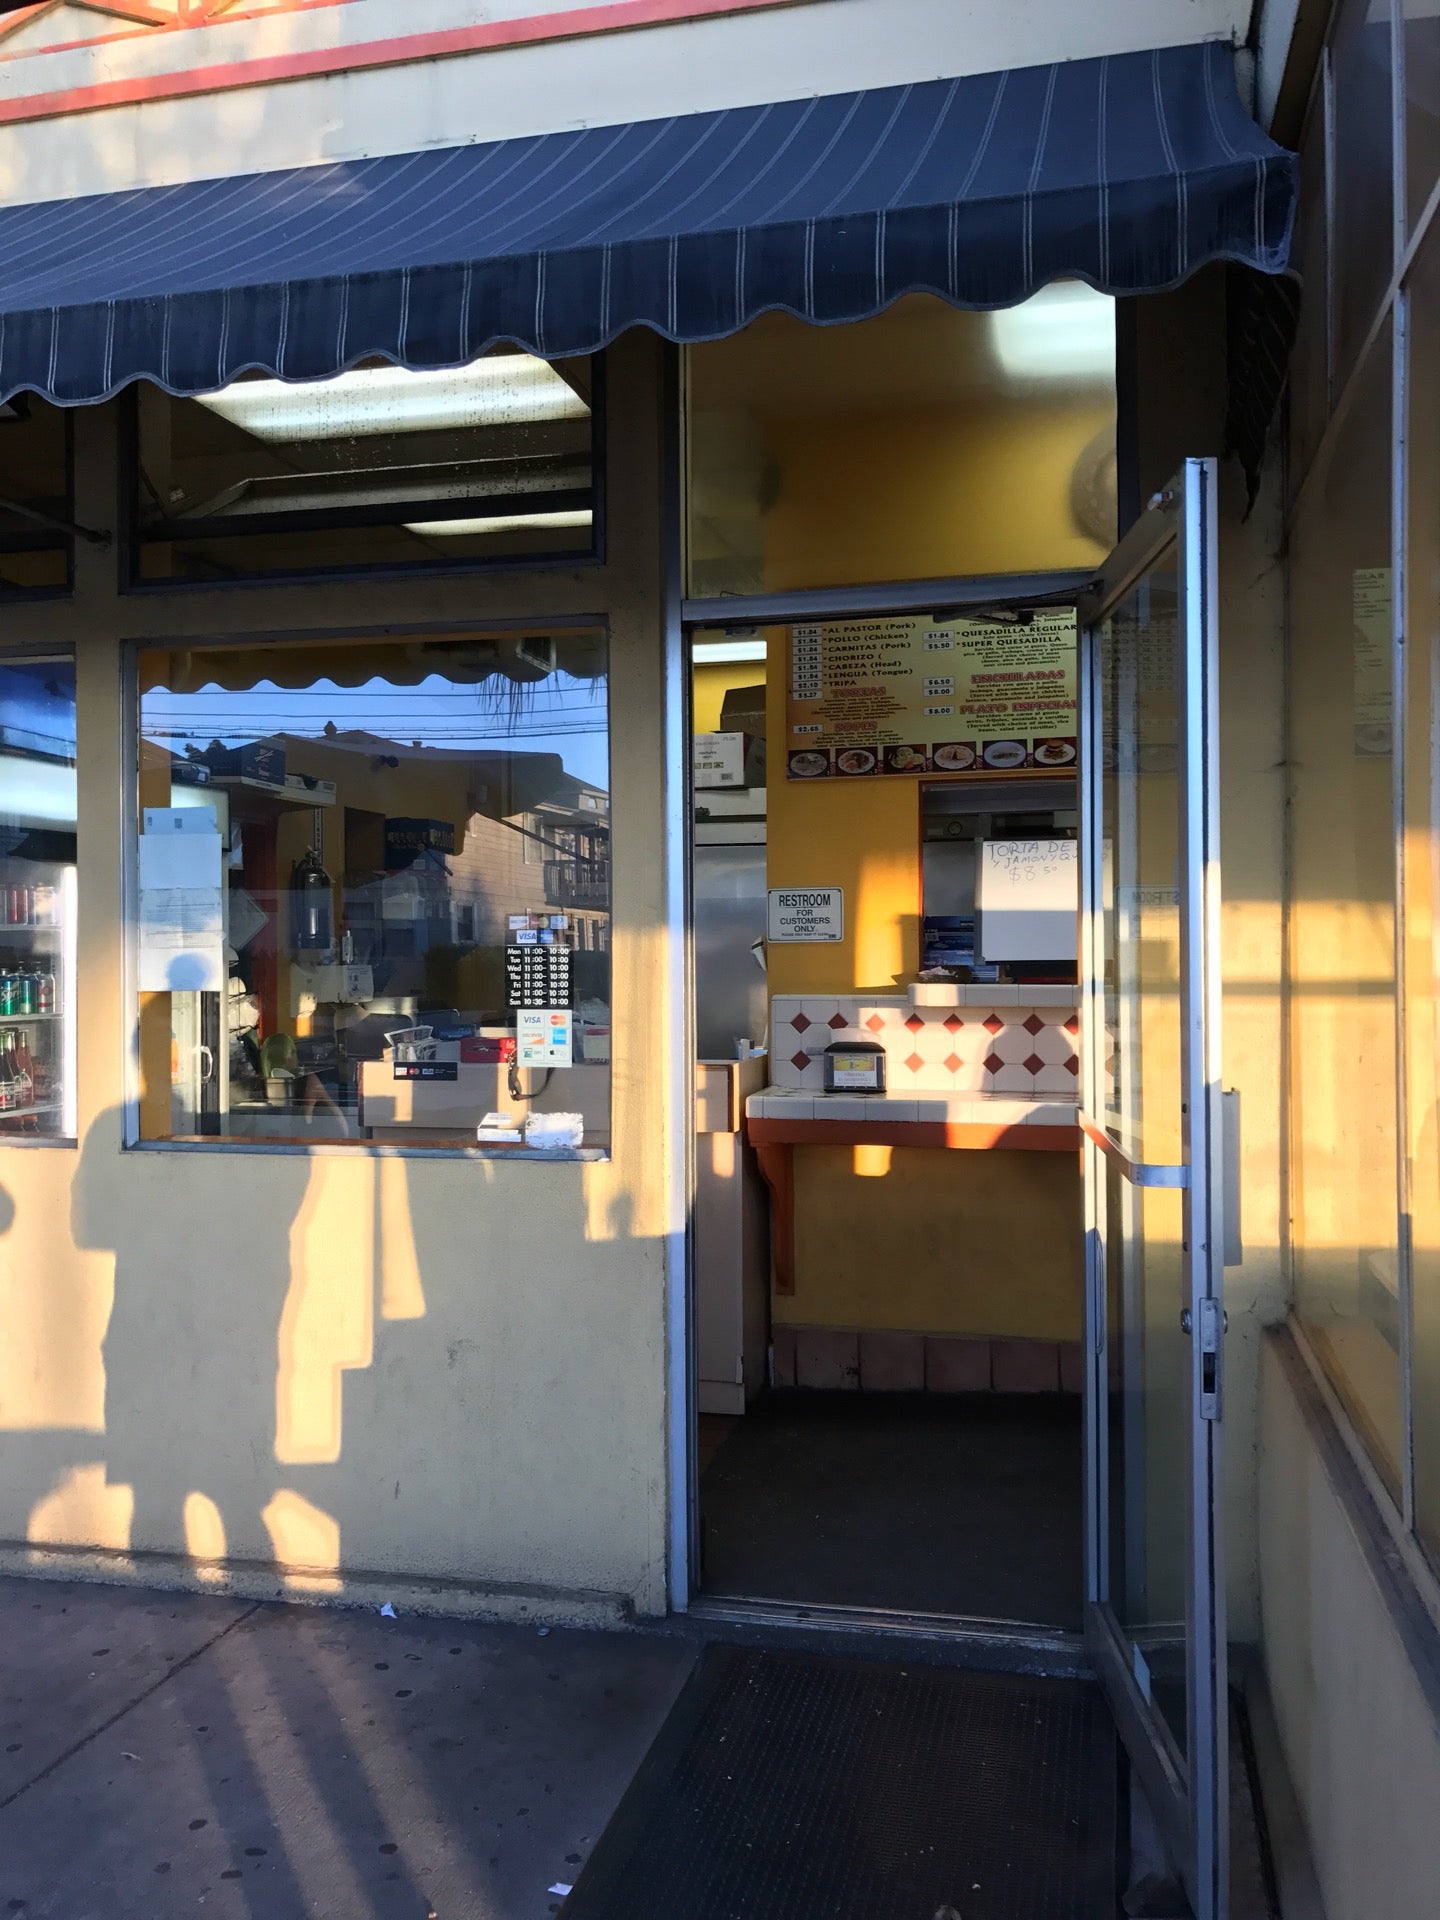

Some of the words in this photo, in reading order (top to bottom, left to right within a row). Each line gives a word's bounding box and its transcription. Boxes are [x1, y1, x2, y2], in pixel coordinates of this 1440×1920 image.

[962, 627, 1026, 637] QUESADILLA
[1030, 624, 1078, 634] REGULAR
[864, 633, 909, 641] (Chicken)
[962, 640, 993, 648] SUPER
[997, 636, 1062, 646] QUESADILLA
[828, 645, 877, 653] CARNITAS
[880, 642, 911, 650] (Pork)
[870, 660, 902, 668] (Head)
[828, 671, 868, 679] LENGUA
[872, 668, 913, 677] (Tongue)
[971, 670, 1065, 684] ENCHILADAS
[960, 703, 1008, 714] PLATO
[1012, 700, 1077, 712] ESPECIAL
[986, 841, 1039, 861] TORTA
[1047, 840, 1075, 853] DE
[779, 894, 831, 906] RESTROOM
[780, 917, 830, 925] CUSTOMERS
[519, 932, 537, 940] VISA
[507, 947, 521, 955] Mon
[507, 964, 521, 972] Wed
[510, 972, 521, 980] Thu
[510, 989, 521, 997] Sat
[523, 1015, 542, 1024] VISA
